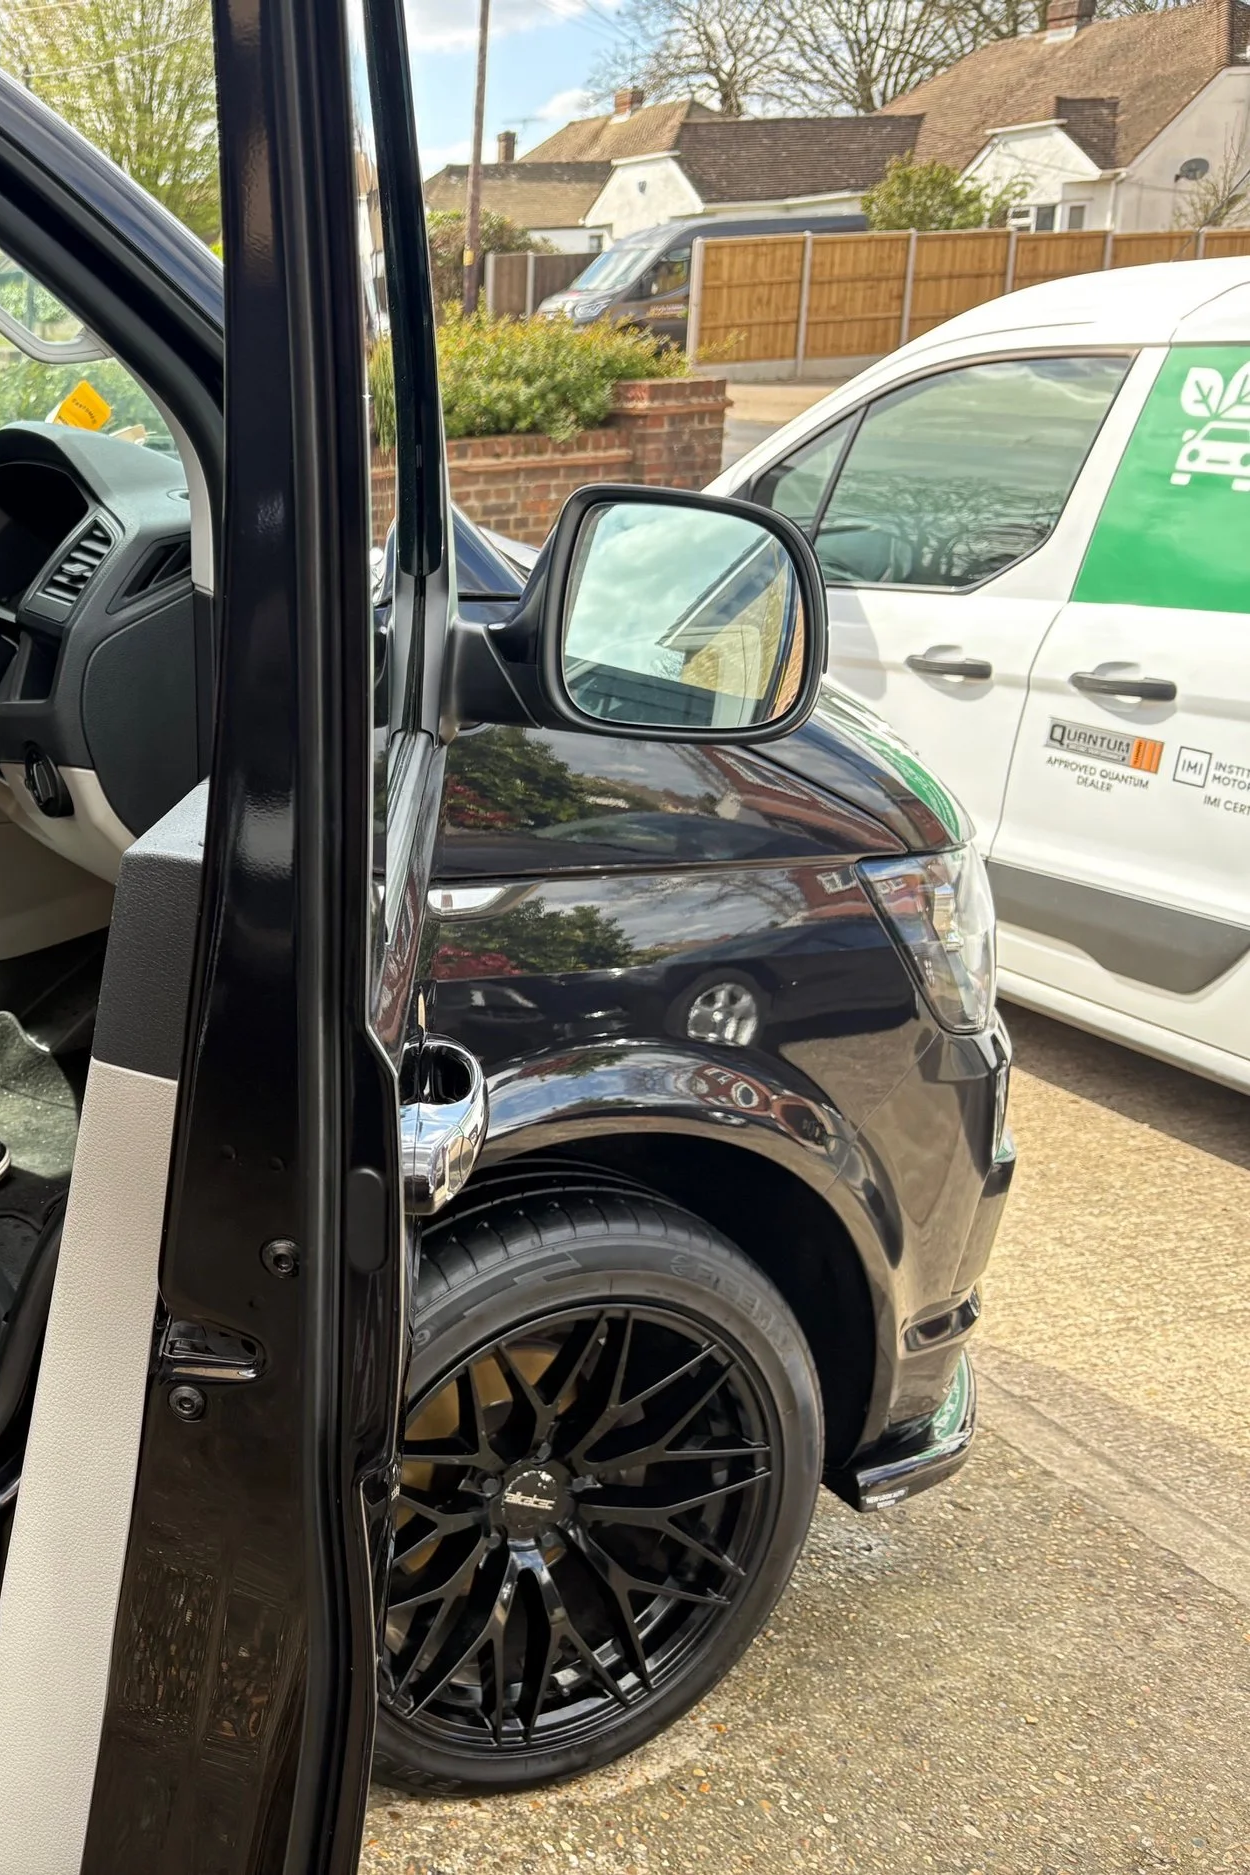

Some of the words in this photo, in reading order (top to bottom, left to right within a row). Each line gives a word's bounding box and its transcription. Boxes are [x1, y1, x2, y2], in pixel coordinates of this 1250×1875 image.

[1049, 723, 1131, 754] QUANTUM
[1046, 755, 1097, 776] APPROVED
[1099, 768, 1150, 789] QUANTUM
[1181, 758, 1203, 776] IMI
[1076, 774, 1113, 793] DEALER
[1203, 794, 1221, 809] IMI
